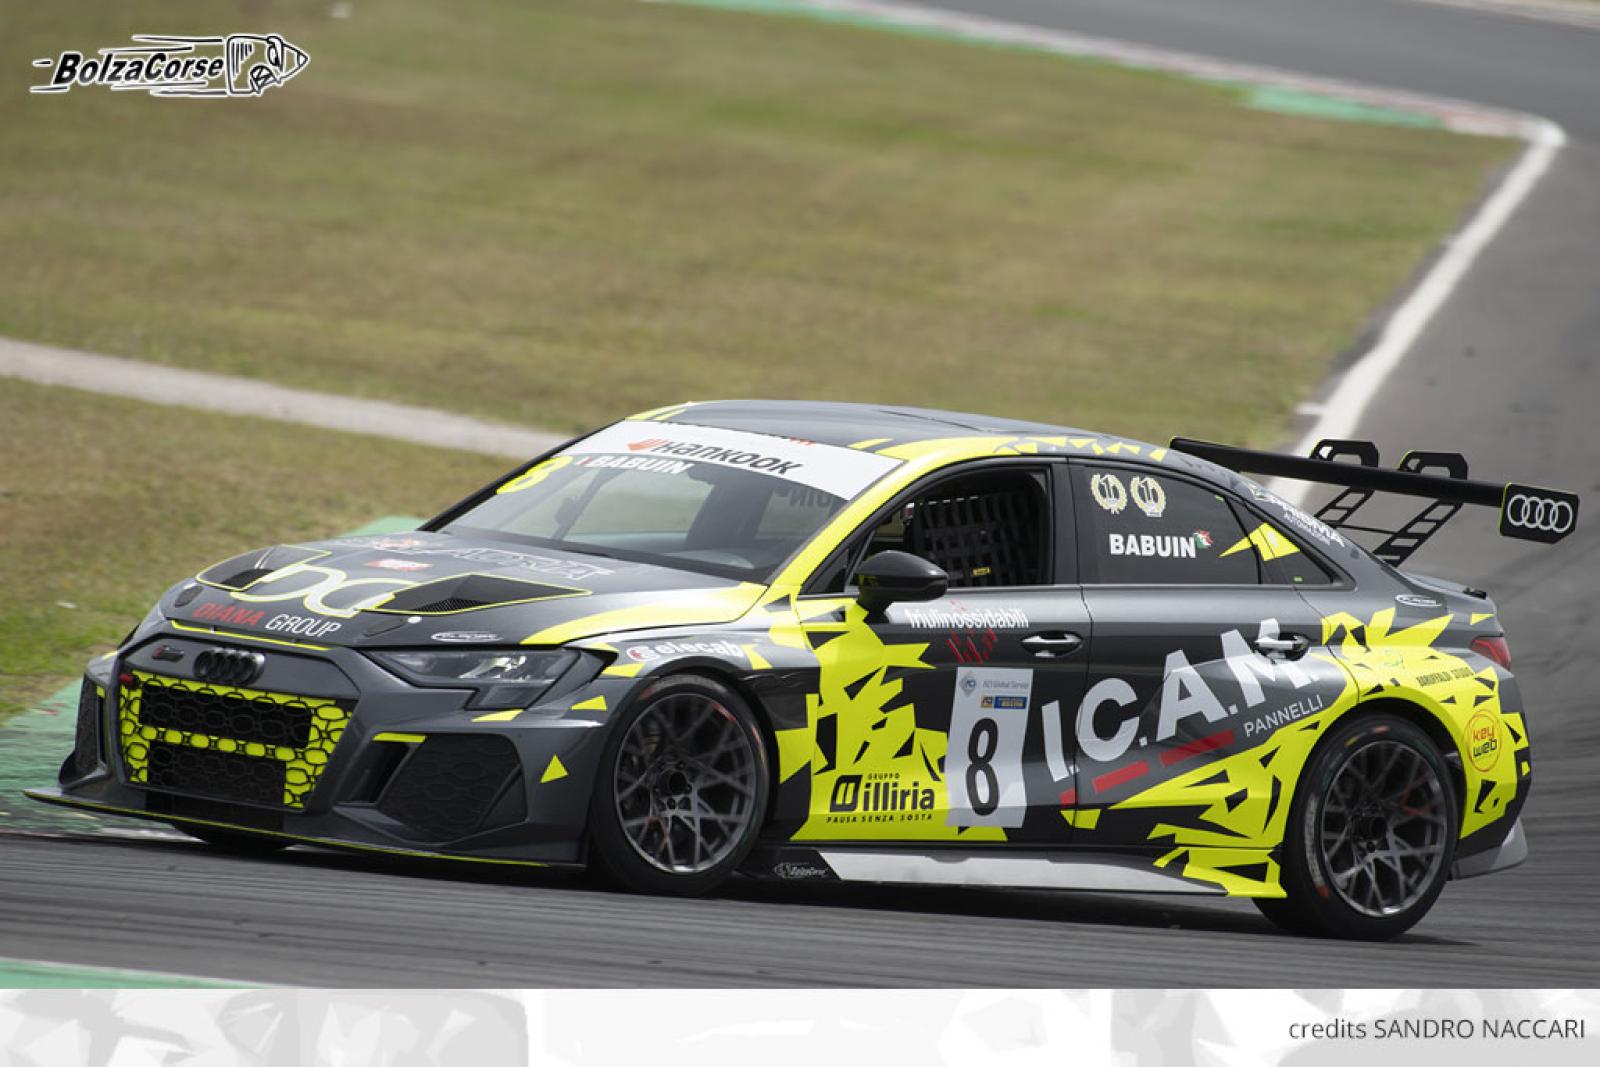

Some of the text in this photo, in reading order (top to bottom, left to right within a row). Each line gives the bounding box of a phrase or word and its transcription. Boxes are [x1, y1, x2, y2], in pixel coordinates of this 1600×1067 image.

[585, 455, 695, 475] BABUIN
[1109, 533, 1196, 558] BABUIN
[193, 602, 343, 638] DIANA GROUP
[1244, 694, 1323, 737] PANNELLI
[867, 772, 900, 780] GRUPPO
[965, 717, 999, 816] 8
[826, 813, 933, 824] PAUSA SENZA SOSTA
